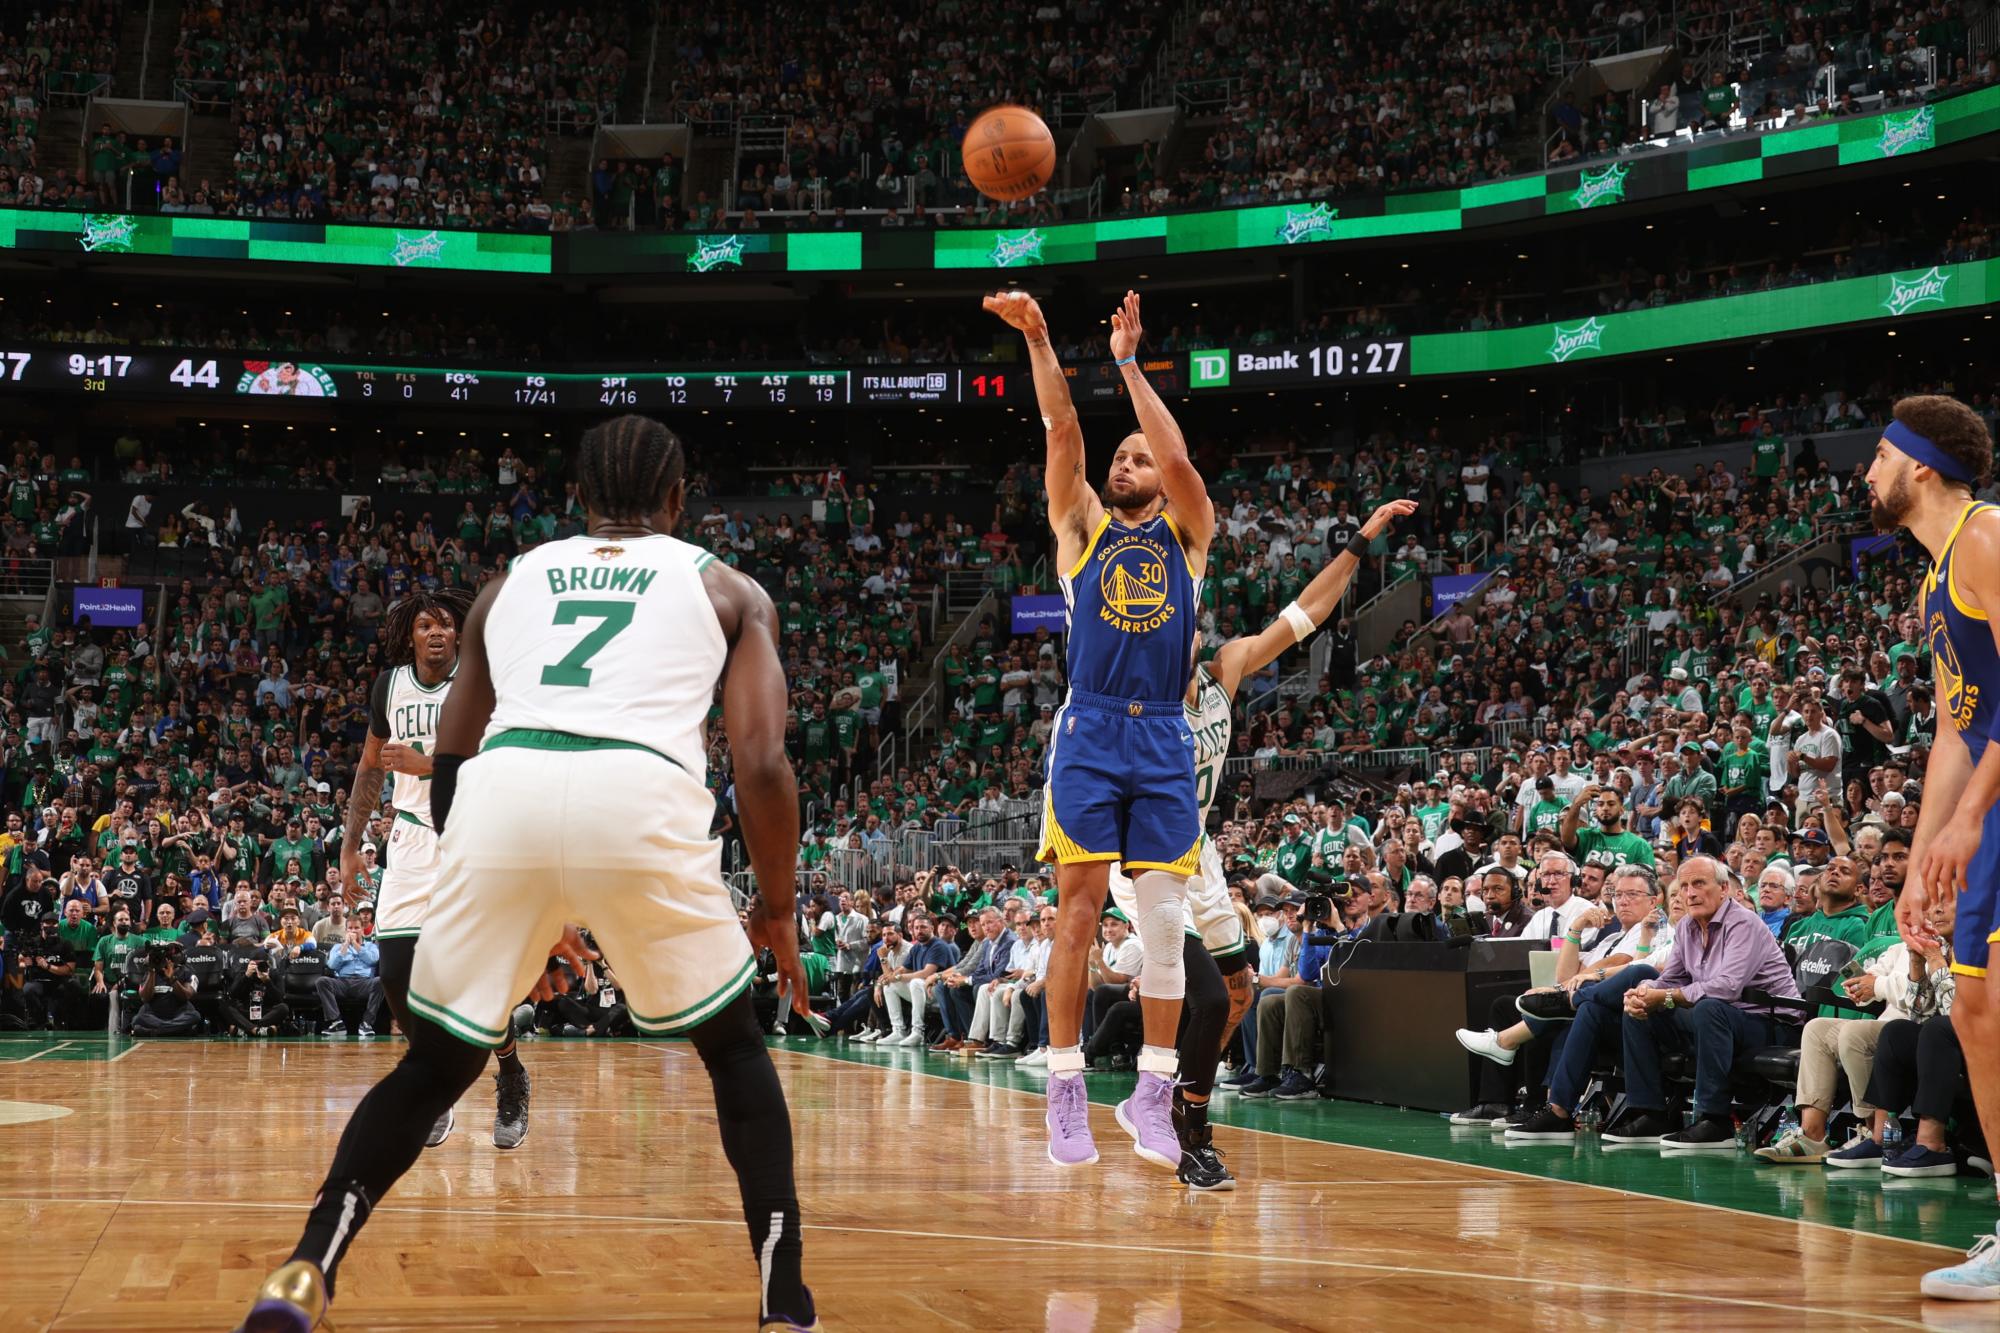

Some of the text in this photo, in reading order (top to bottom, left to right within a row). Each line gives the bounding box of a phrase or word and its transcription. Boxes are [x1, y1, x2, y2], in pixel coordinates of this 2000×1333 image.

[699, 245, 739, 262] Sprite
[1893, 279, 1942, 308] Sprite
[1556, 327, 1600, 353] Sprite
[68, 353, 132, 377] 9:17
[1194, 356, 1226, 380] TD
[1238, 350, 1299, 372] Bank
[1309, 342, 1404, 376] 10:27
[0, 352, 31, 381] 7
[169, 359, 220, 388] 44
[356, 371, 377, 381] TOL
[395, 373, 417, 382] FLS
[445, 373, 479, 385] FG%
[526, 376, 546, 388] FG
[601, 377, 628, 388] 3PT
[666, 376, 686, 387] TO
[714, 375, 738, 387] STL
[761, 375, 789, 386] AST
[809, 374, 835, 386] REB
[881, 376, 897, 389] ALL
[897, 376, 926, 389] ABOUT
[929, 375, 943, 388] 18
[83, 378, 105, 392] 3rd
[362, 383, 372, 397] 3
[403, 384, 413, 398] 0
[972, 375, 1005, 396] 11
[450, 387, 469, 400] 41
[514, 389, 556, 405] 17/41
[600, 390, 637, 406] 4/16
[670, 390, 687, 404] 12
[723, 389, 732, 402] 7
[769, 389, 786, 402] 15
[816, 389, 833, 401] 19
[1097, 535, 1169, 561] GOLDEN STATE
[1139, 562, 1162, 583] 30
[102, 577, 117, 589] EXIT
[546, 566, 658, 595] BROWN
[1100, 603, 1176, 633] WARRIORS
[540, 600, 637, 687] 7
[1204, 692, 1220, 705] VISTA
[1129, 703, 1143, 714] W
[395, 703, 441, 741] CELTI
[1800, 957, 1832, 975] @celtics
